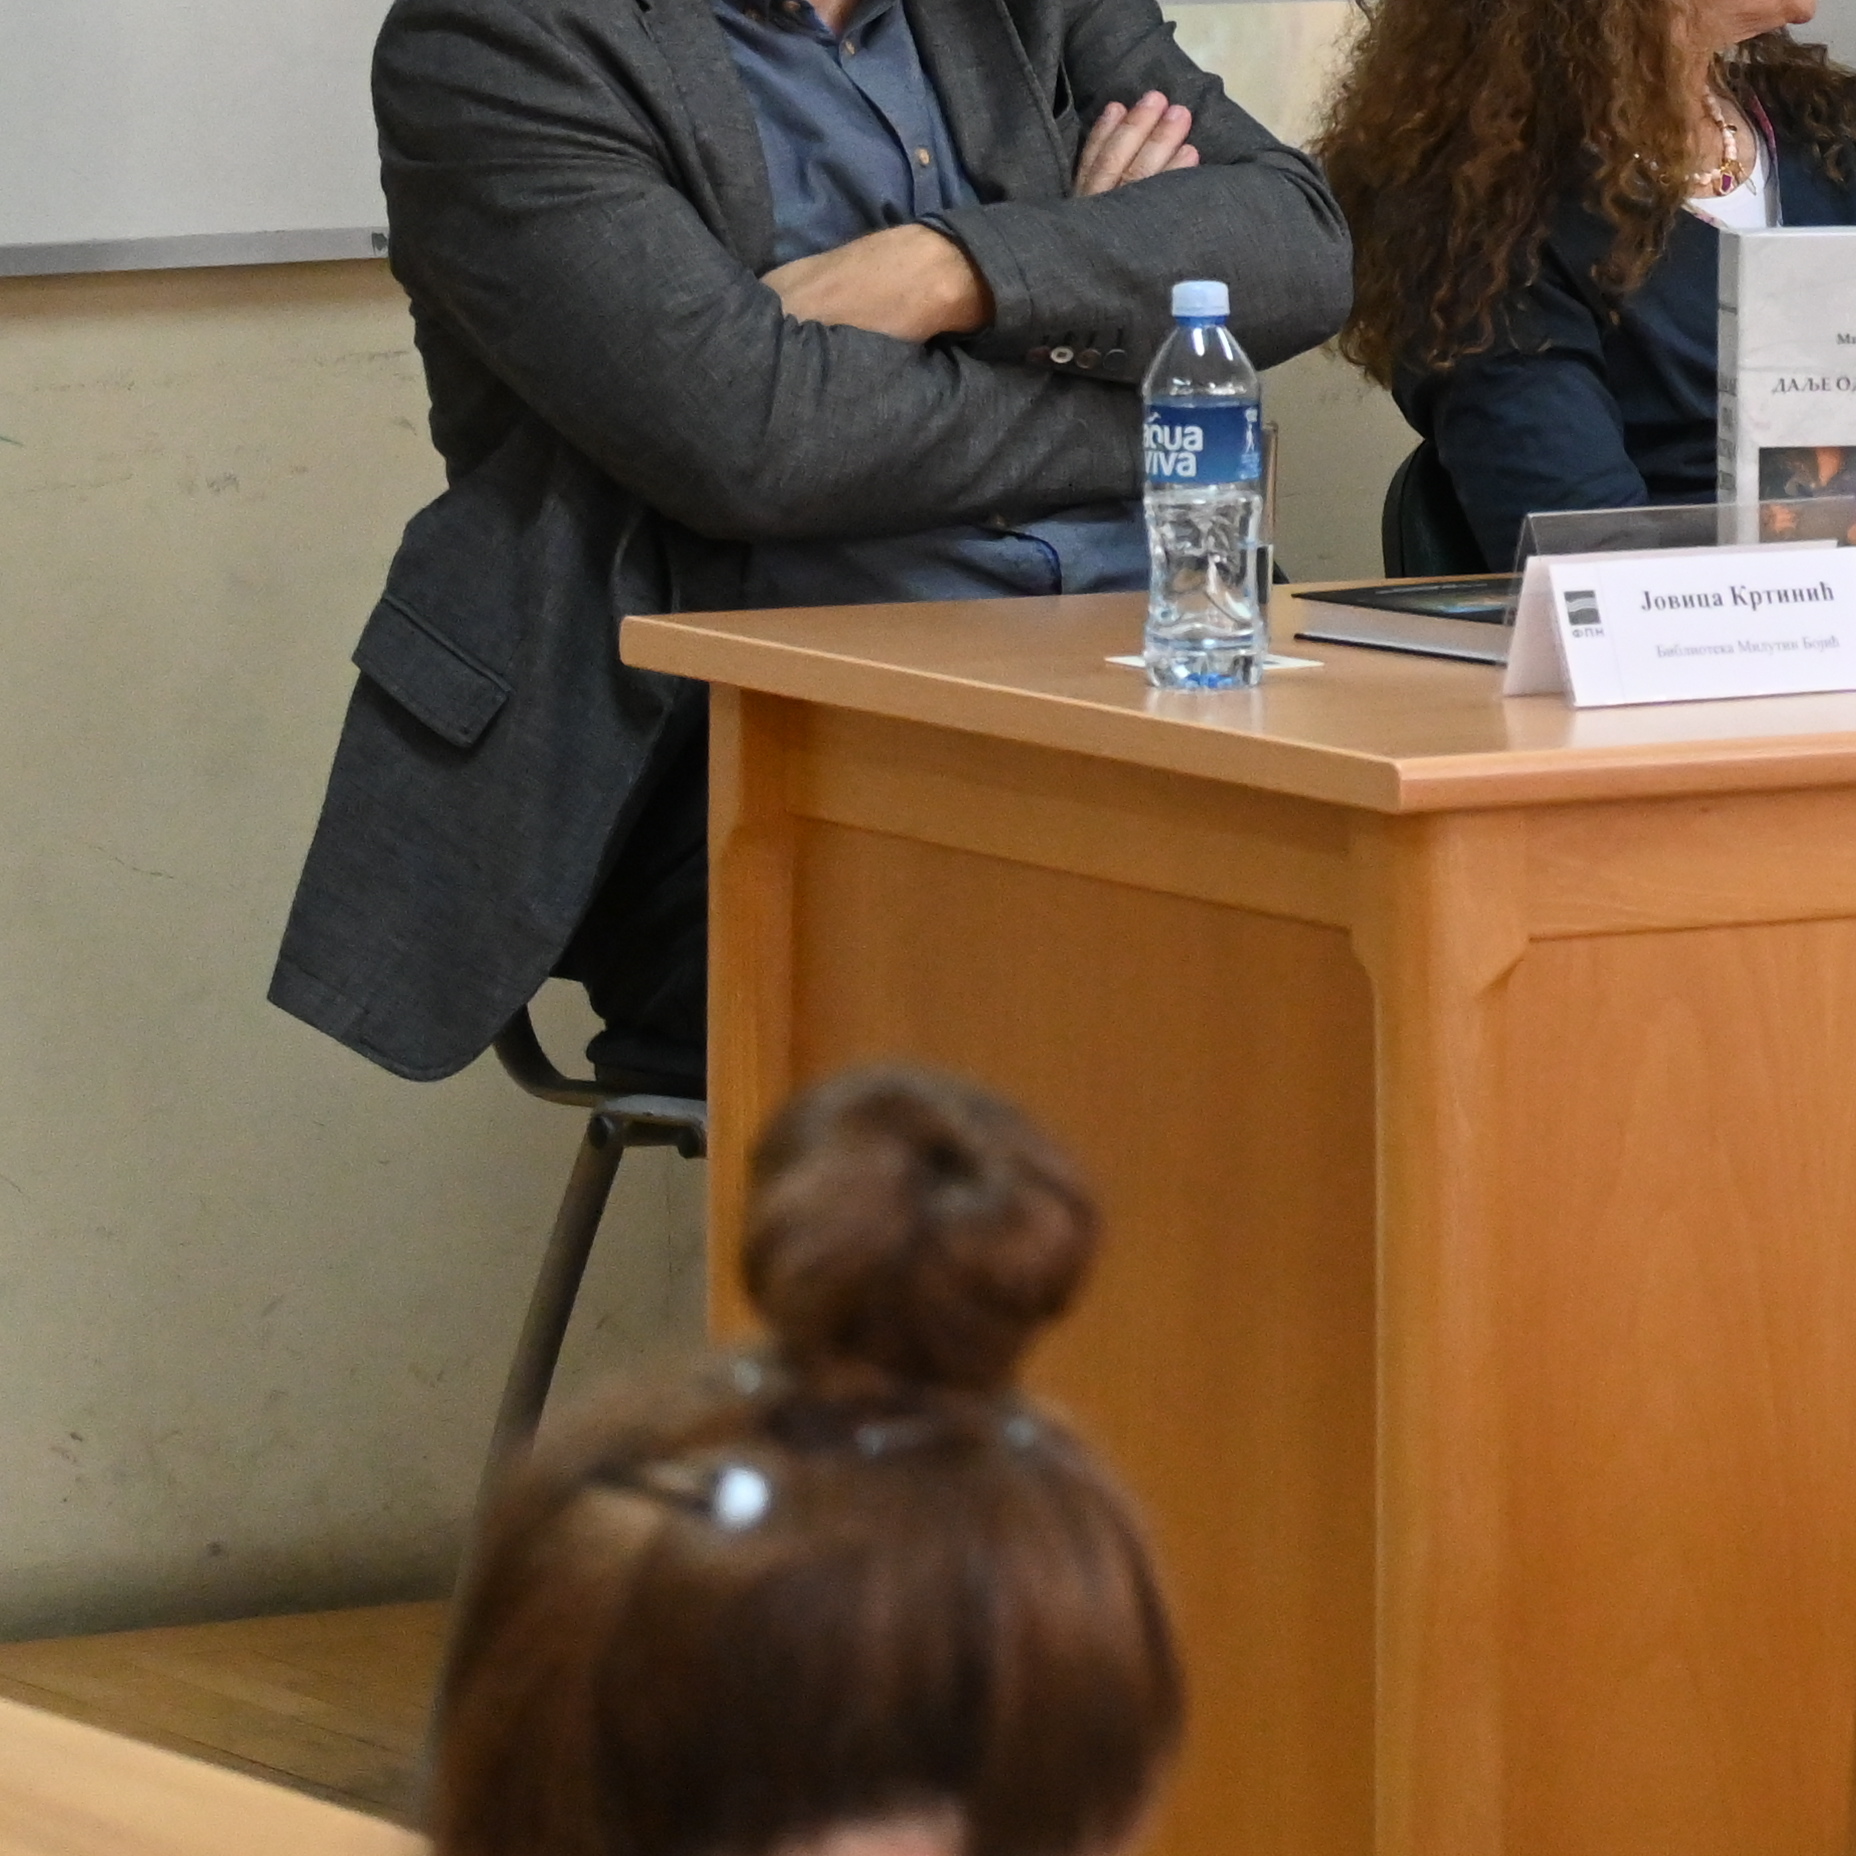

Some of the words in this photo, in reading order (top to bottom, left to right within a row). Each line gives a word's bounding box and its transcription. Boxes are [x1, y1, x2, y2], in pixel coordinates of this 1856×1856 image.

[1771, 377, 1832, 394] ДАЉЕ
[1640, 589, 1724, 612] Јовица
[1730, 580, 1835, 612] Кртинић
[1571, 626, 1606, 639] ФПН
[1656, 642, 1735, 659] Библиотека
[1802, 634, 1841, 654] Бојић
